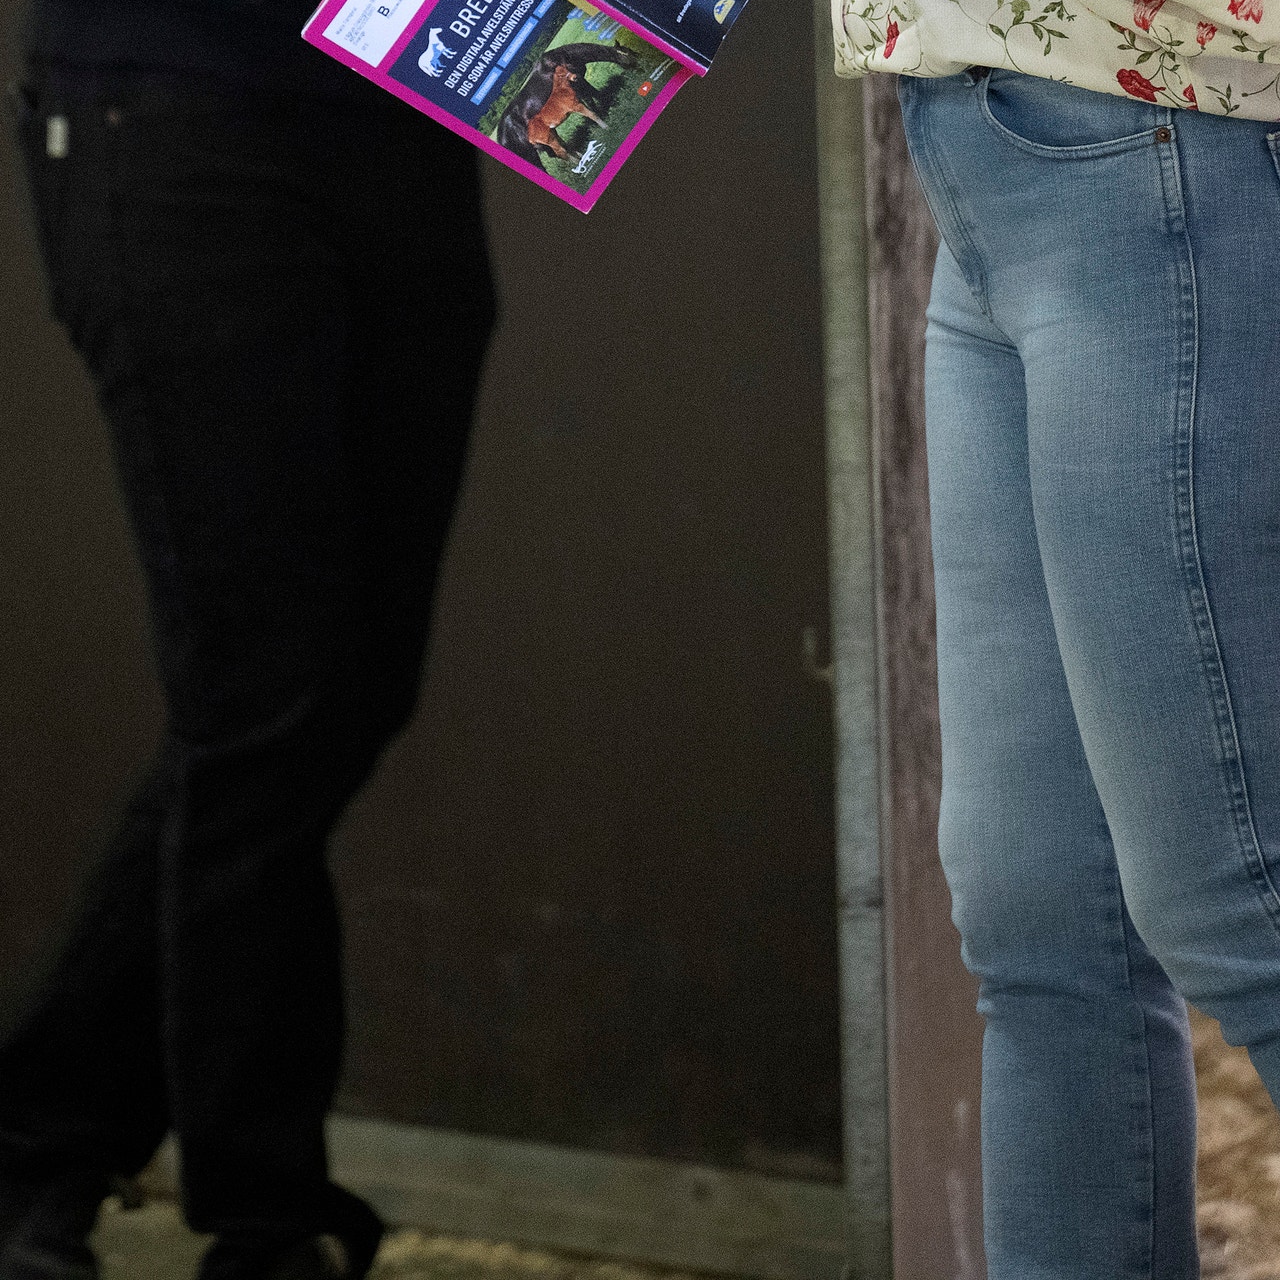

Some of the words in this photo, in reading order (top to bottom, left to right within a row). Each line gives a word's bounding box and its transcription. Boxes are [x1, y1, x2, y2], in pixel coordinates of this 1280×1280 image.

[377, 3, 391, 18] B
[443, 68, 462, 89] DEN
[455, 34, 487, 73] DIGITALA
[456, 78, 474, 97] DIG
[466, 59, 487, 83] SOM
[478, 47, 495, 64] ÄR
